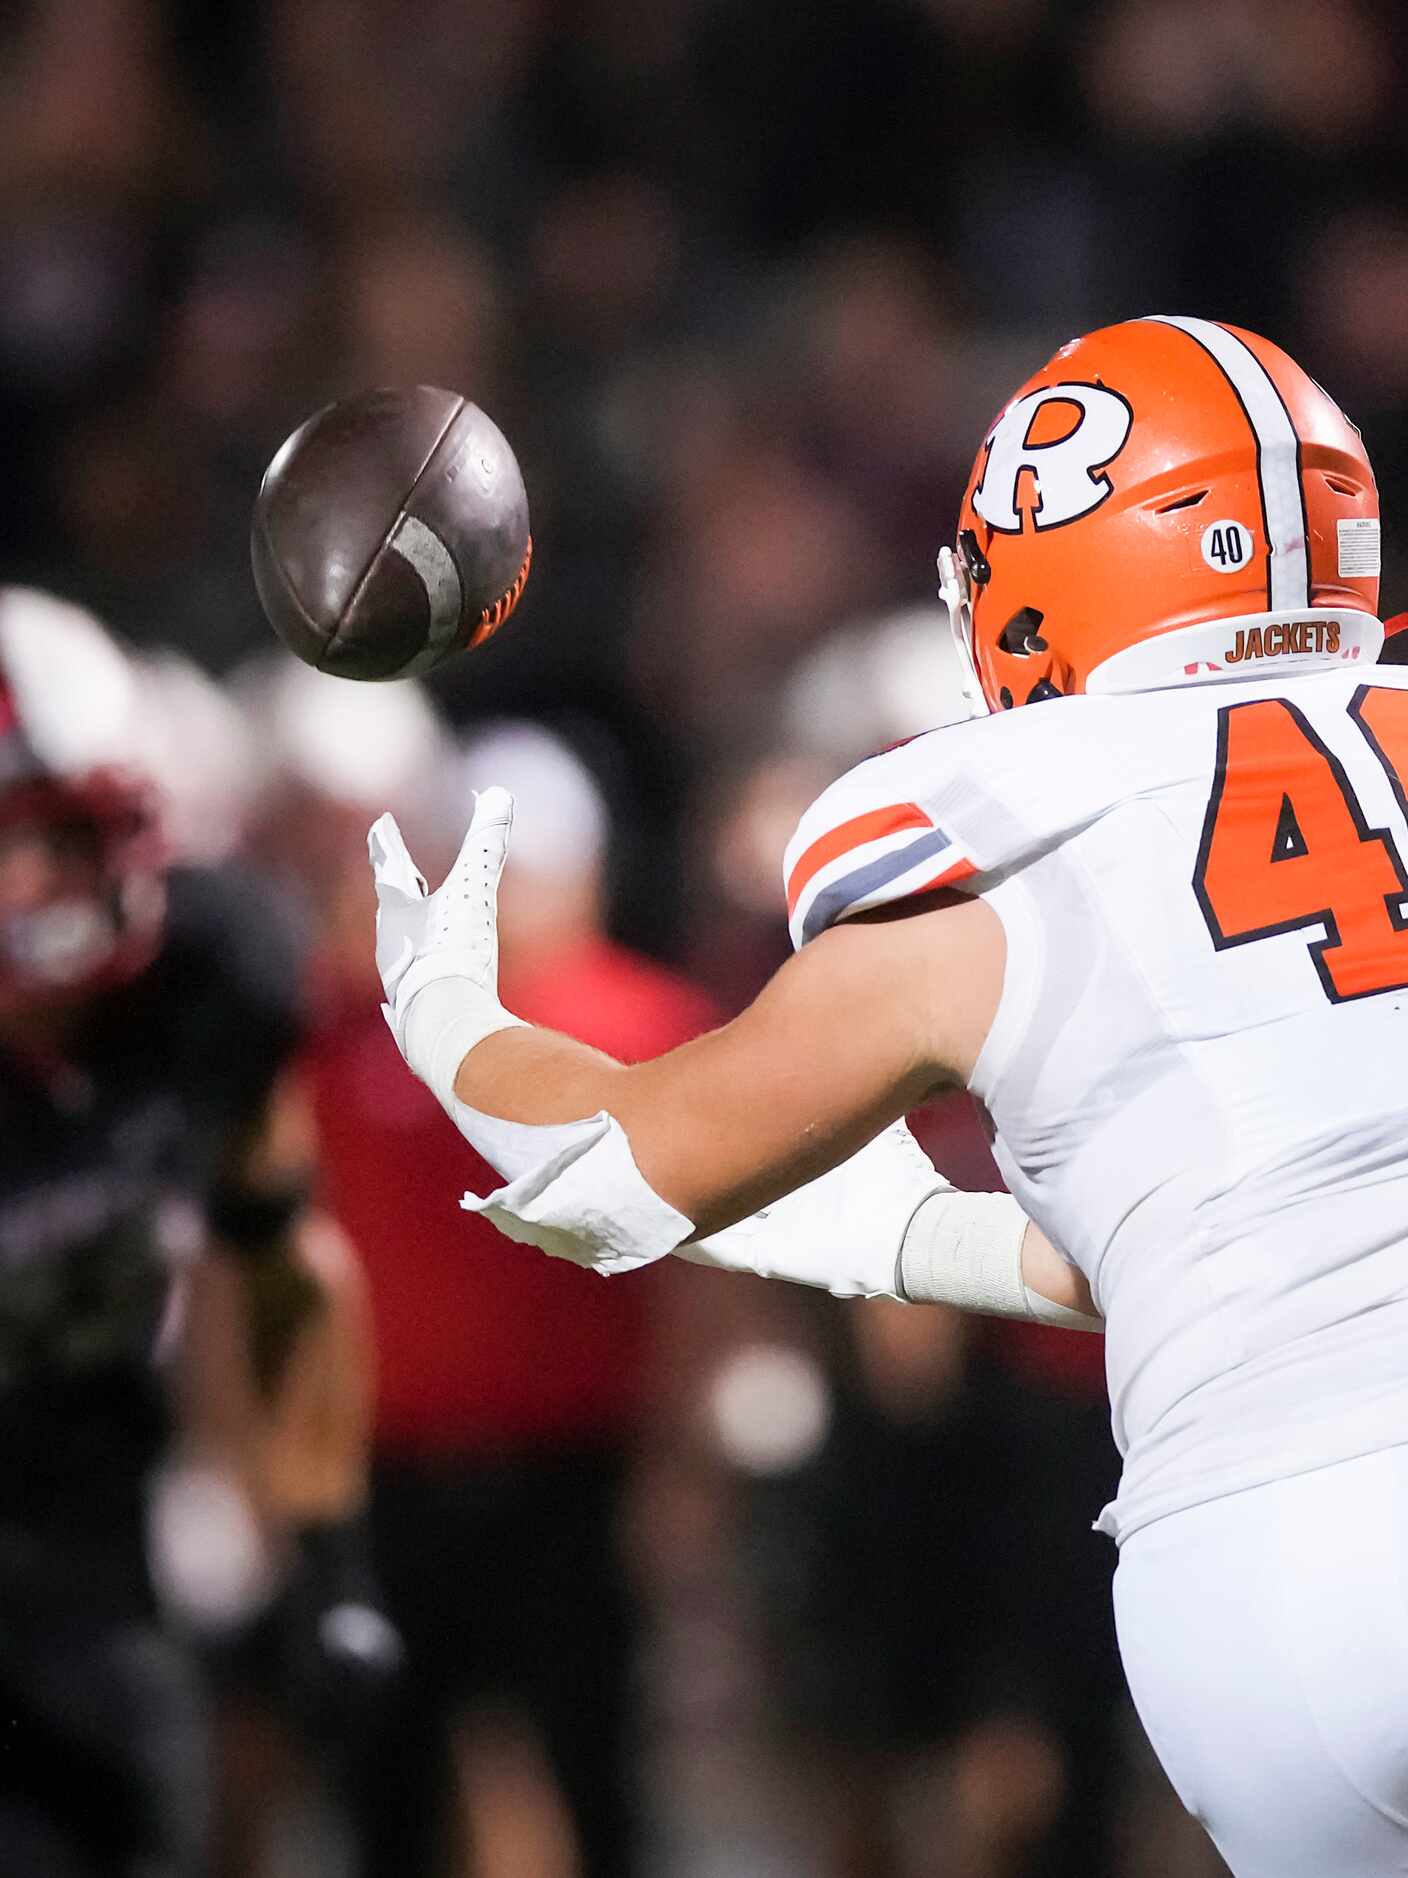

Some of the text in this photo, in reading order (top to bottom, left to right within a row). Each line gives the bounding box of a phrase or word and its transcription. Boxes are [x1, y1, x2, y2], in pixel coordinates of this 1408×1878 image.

[971, 381, 1134, 534] R
[1210, 526, 1243, 566] 40
[1225, 621, 1341, 663] JACKETS
